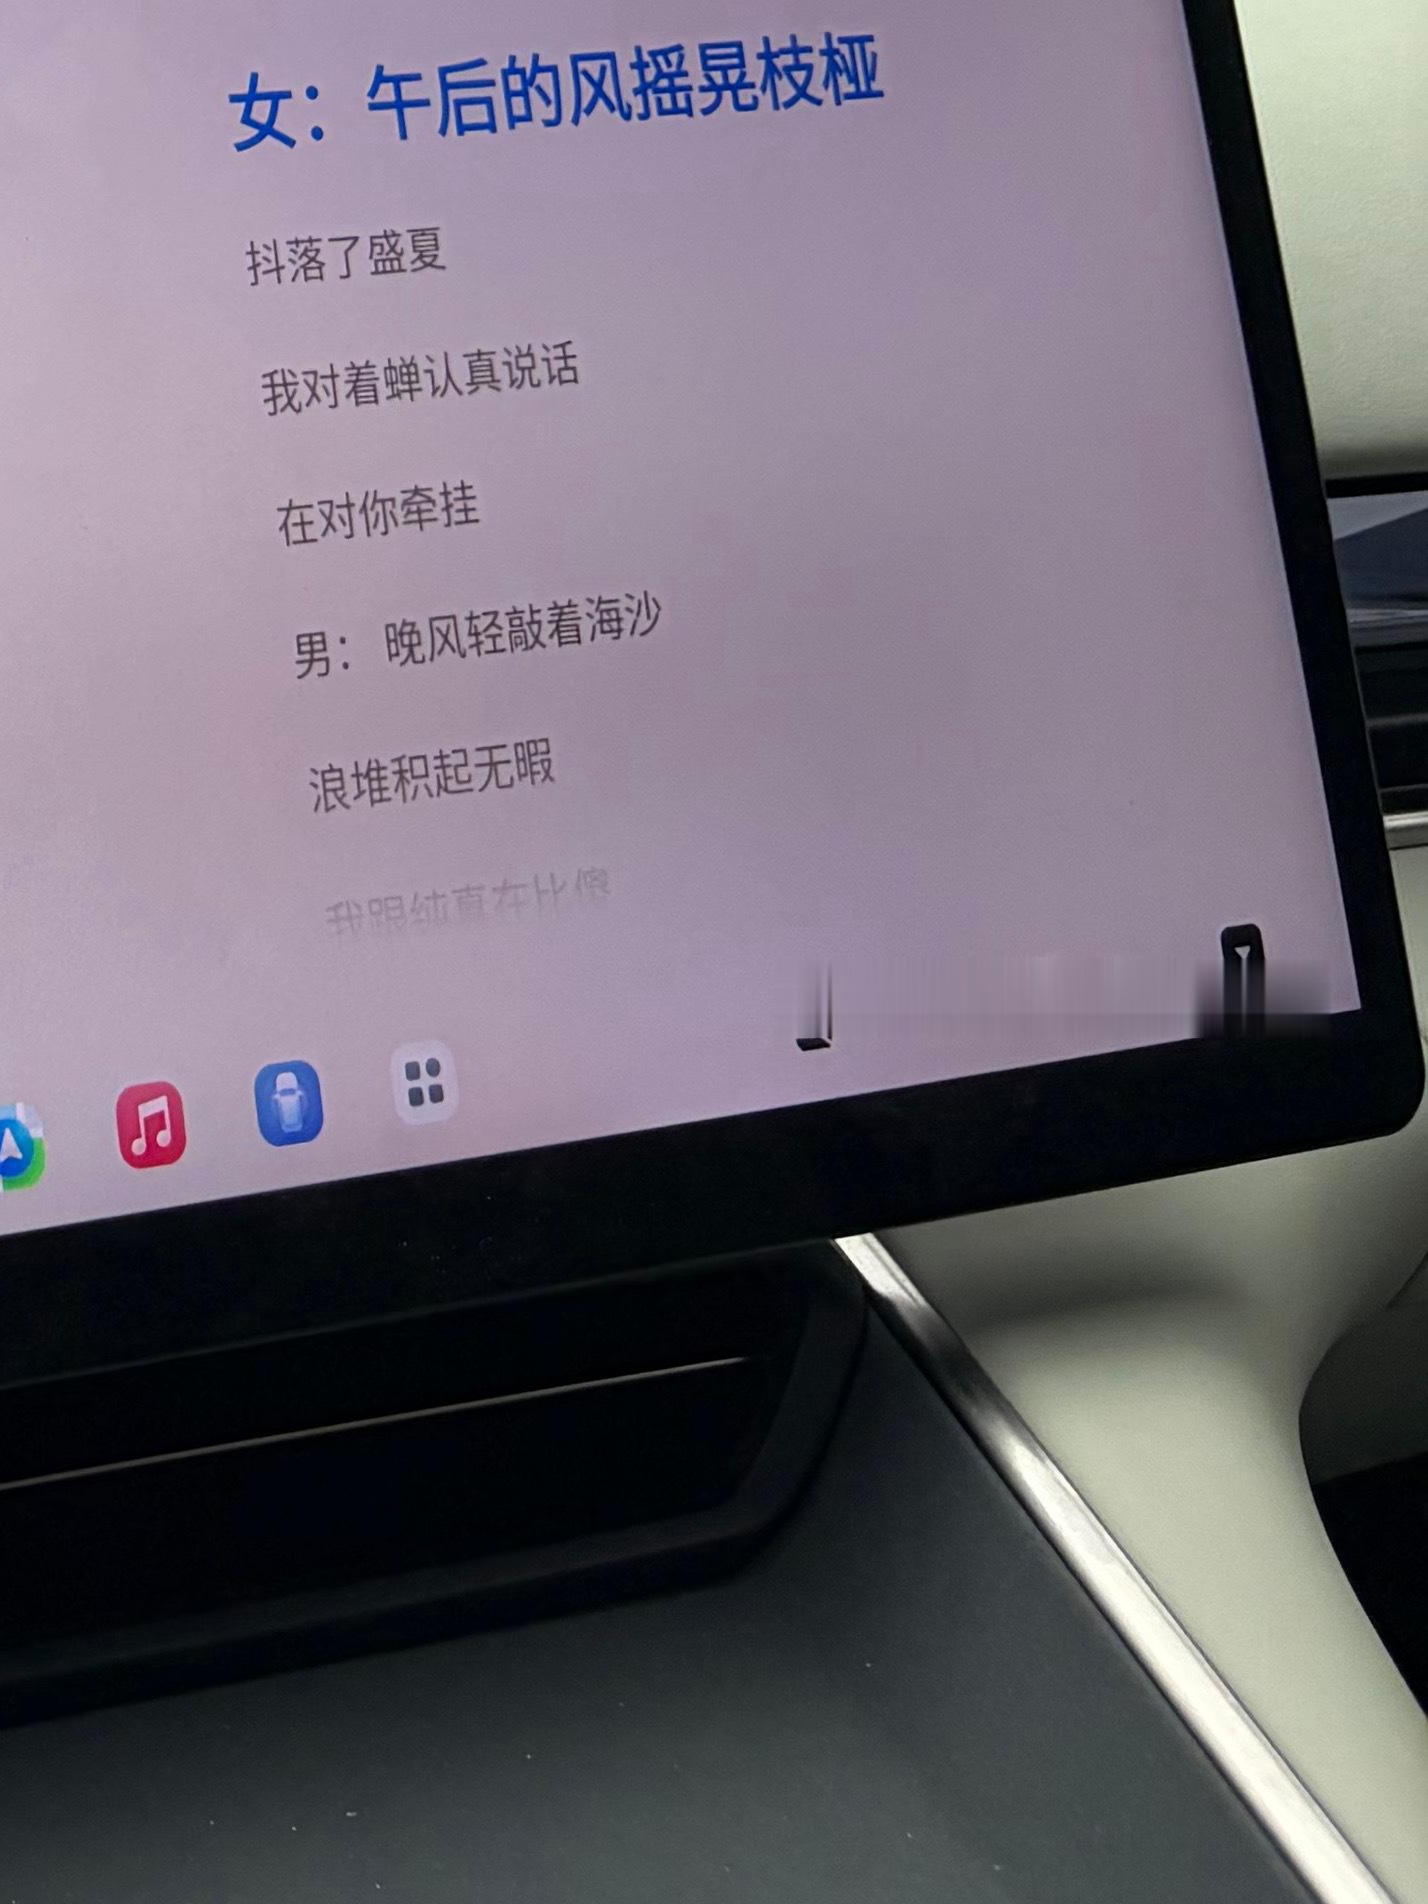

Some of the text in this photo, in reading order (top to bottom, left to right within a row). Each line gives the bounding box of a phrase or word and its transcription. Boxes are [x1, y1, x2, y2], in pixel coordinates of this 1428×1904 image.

[246, 227, 447, 287] 抖落了盛夏
[261, 341, 579, 416] 我对着蝉认真说话
[276, 480, 481, 547] 在对你牵挂
[309, 738, 555, 814] 浪堆积起无暇
